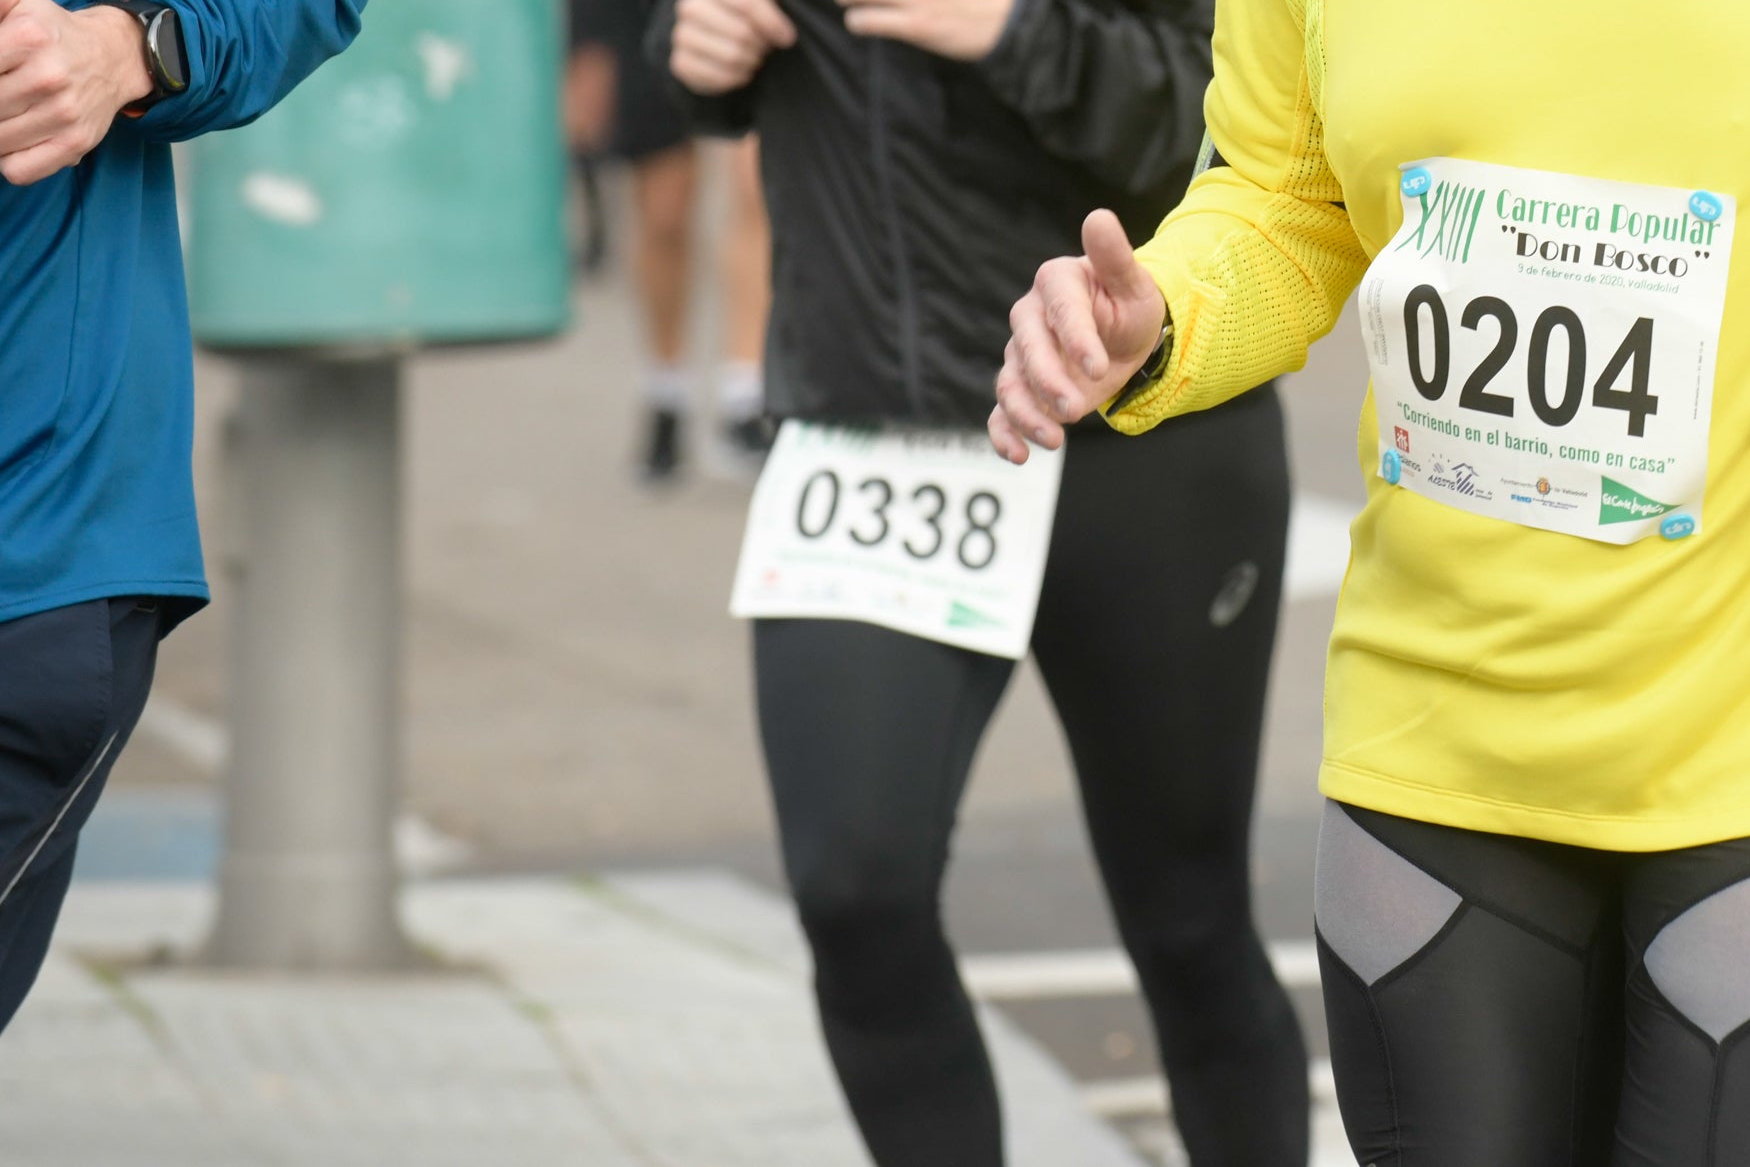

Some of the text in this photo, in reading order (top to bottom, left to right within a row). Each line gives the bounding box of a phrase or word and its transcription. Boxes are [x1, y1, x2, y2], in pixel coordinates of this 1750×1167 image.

[1394, 180, 1486, 264] XXIII
[1496, 188, 1600, 232] Carrera
[1610, 203, 1721, 246] Popular
[1517, 263, 1524, 274] 9
[1526, 265, 1539, 275] de
[1540, 266, 1582, 283] febrero
[1584, 273, 1597, 284] de
[1599, 273, 1626, 289] 2020,
[1403, 283, 1660, 438] 0204
[1465, 427, 1481, 443] en
[1487, 429, 1499, 446] el
[1505, 431, 1553, 459] barrio,
[1559, 444, 1600, 465] como
[1606, 452, 1624, 468] en
[1629, 455, 1676, 474] casa”
[795, 470, 1004, 571] 0338
